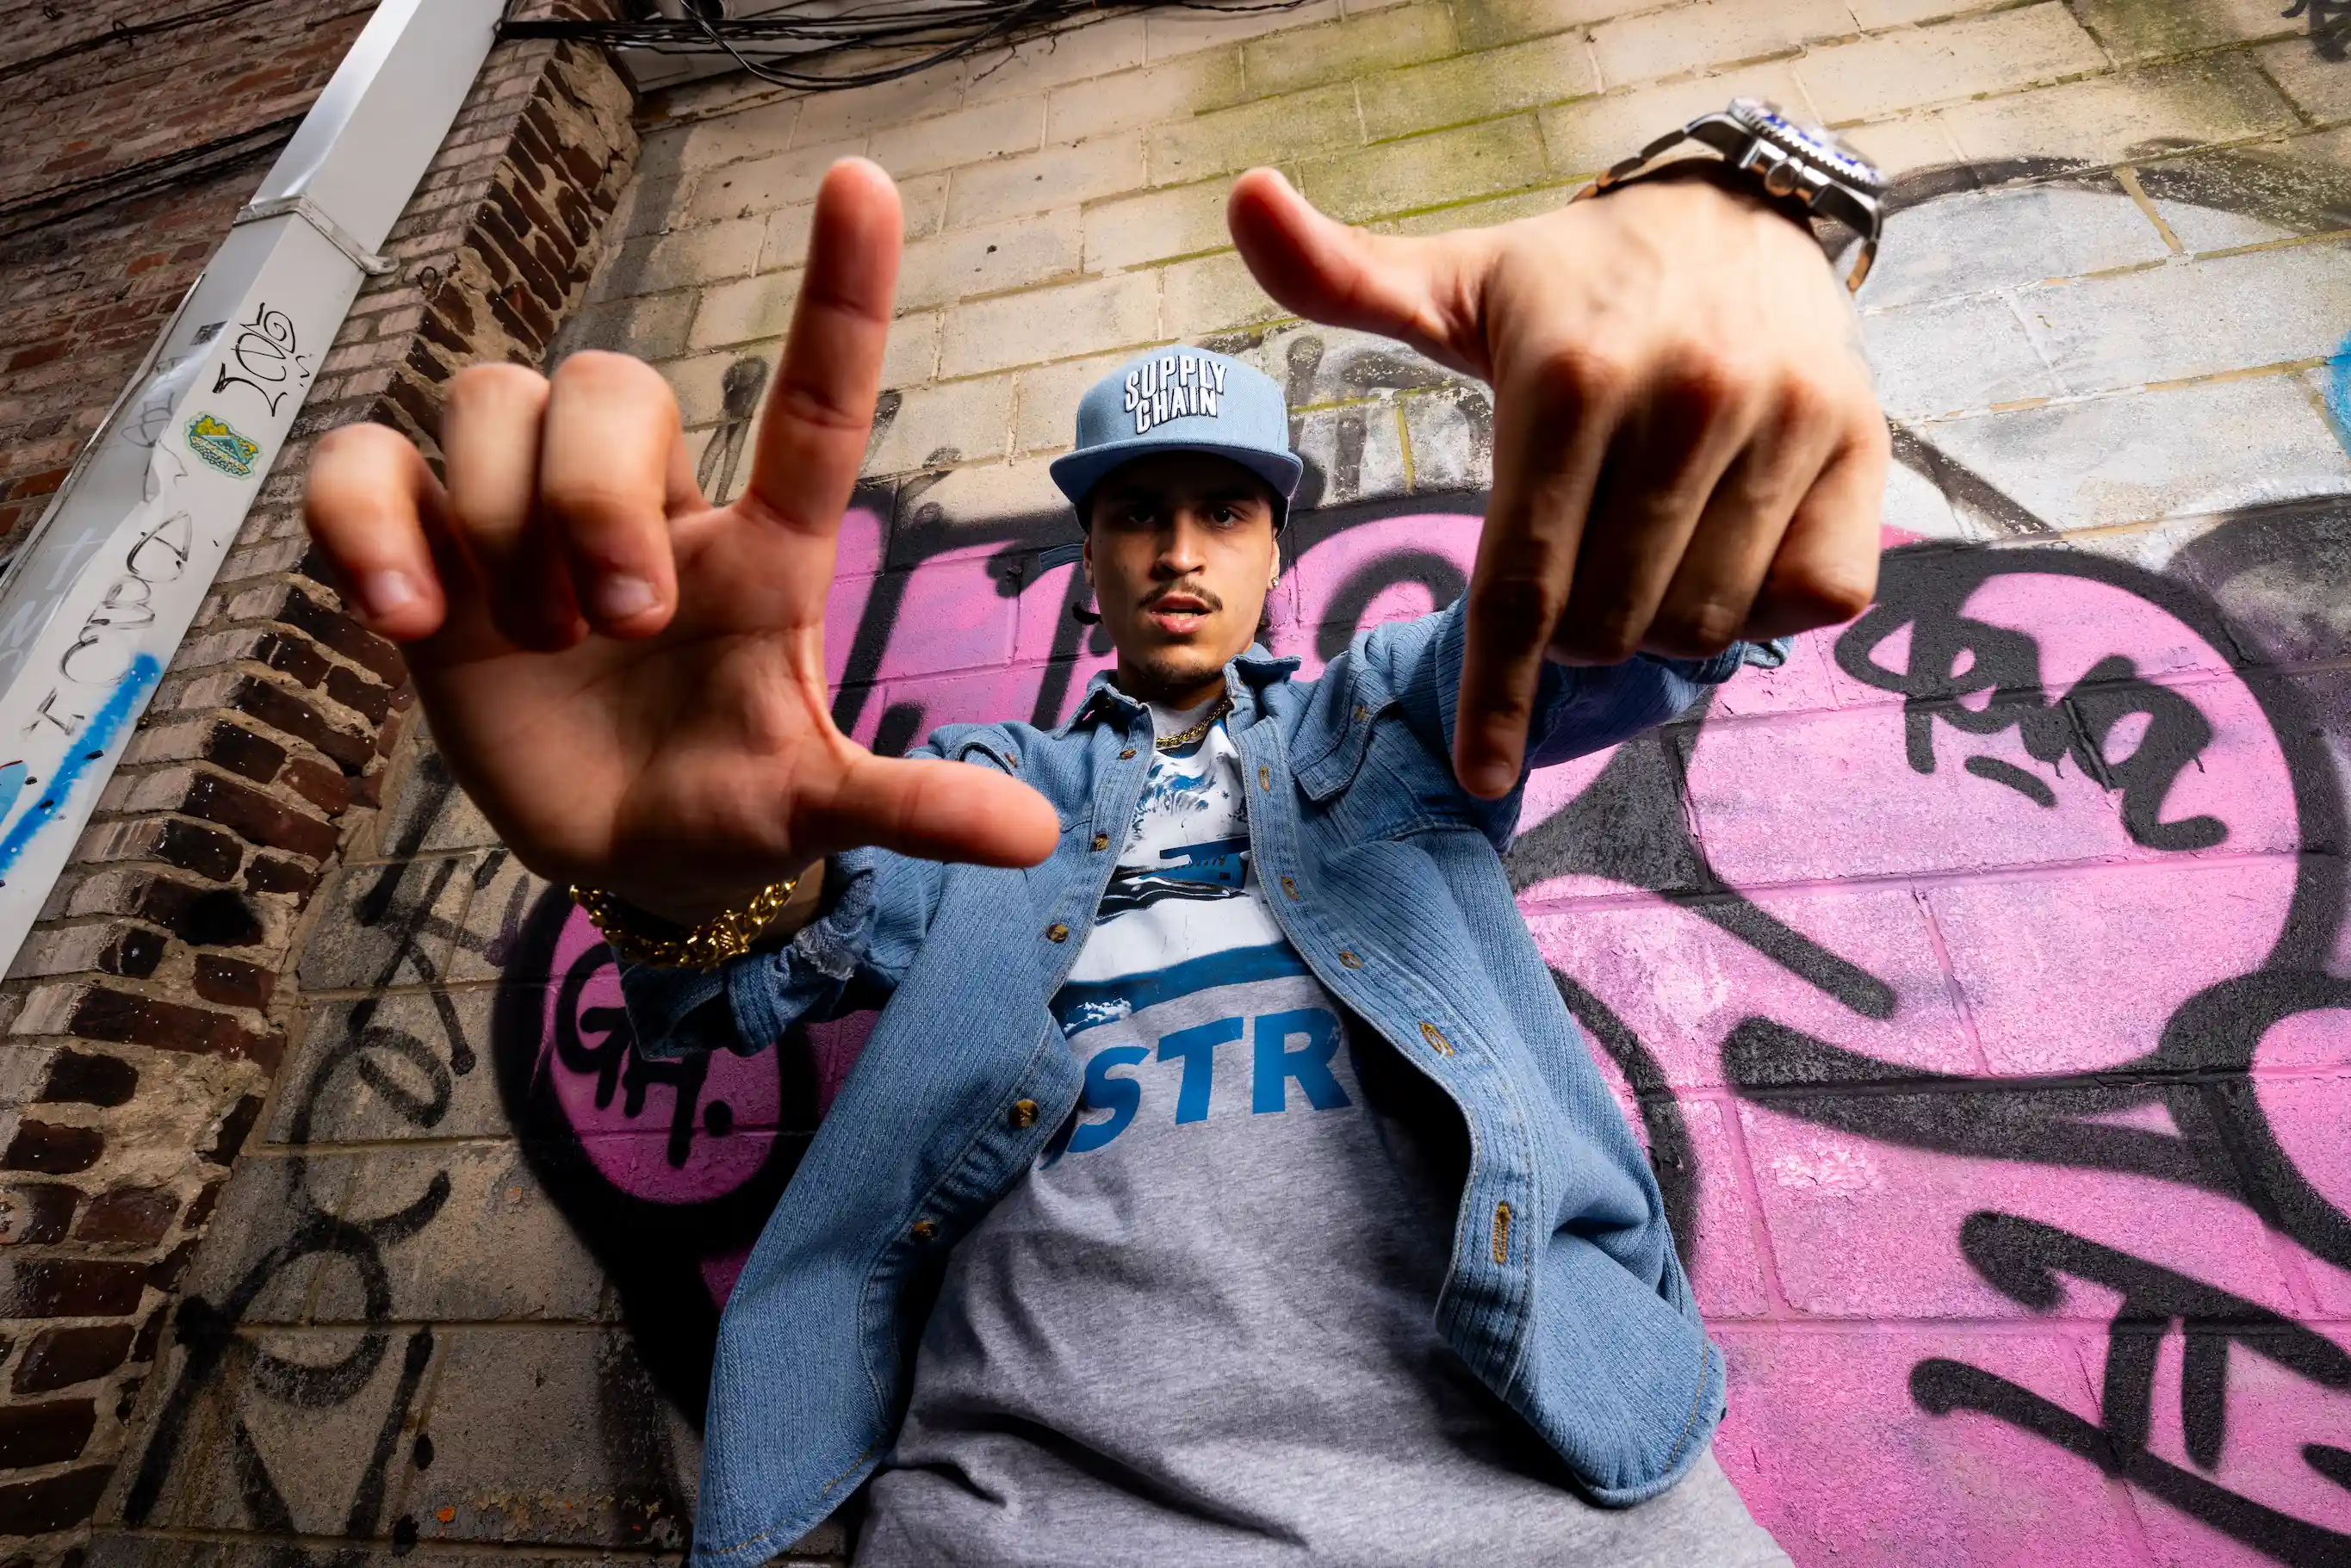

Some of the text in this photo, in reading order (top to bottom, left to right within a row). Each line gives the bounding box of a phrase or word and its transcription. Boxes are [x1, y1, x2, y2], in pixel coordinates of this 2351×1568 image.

[1125, 355, 1226, 413] SUPPLY
[1135, 385, 1218, 435] CHAIN
[1039, 1007, 1352, 1170] STR
